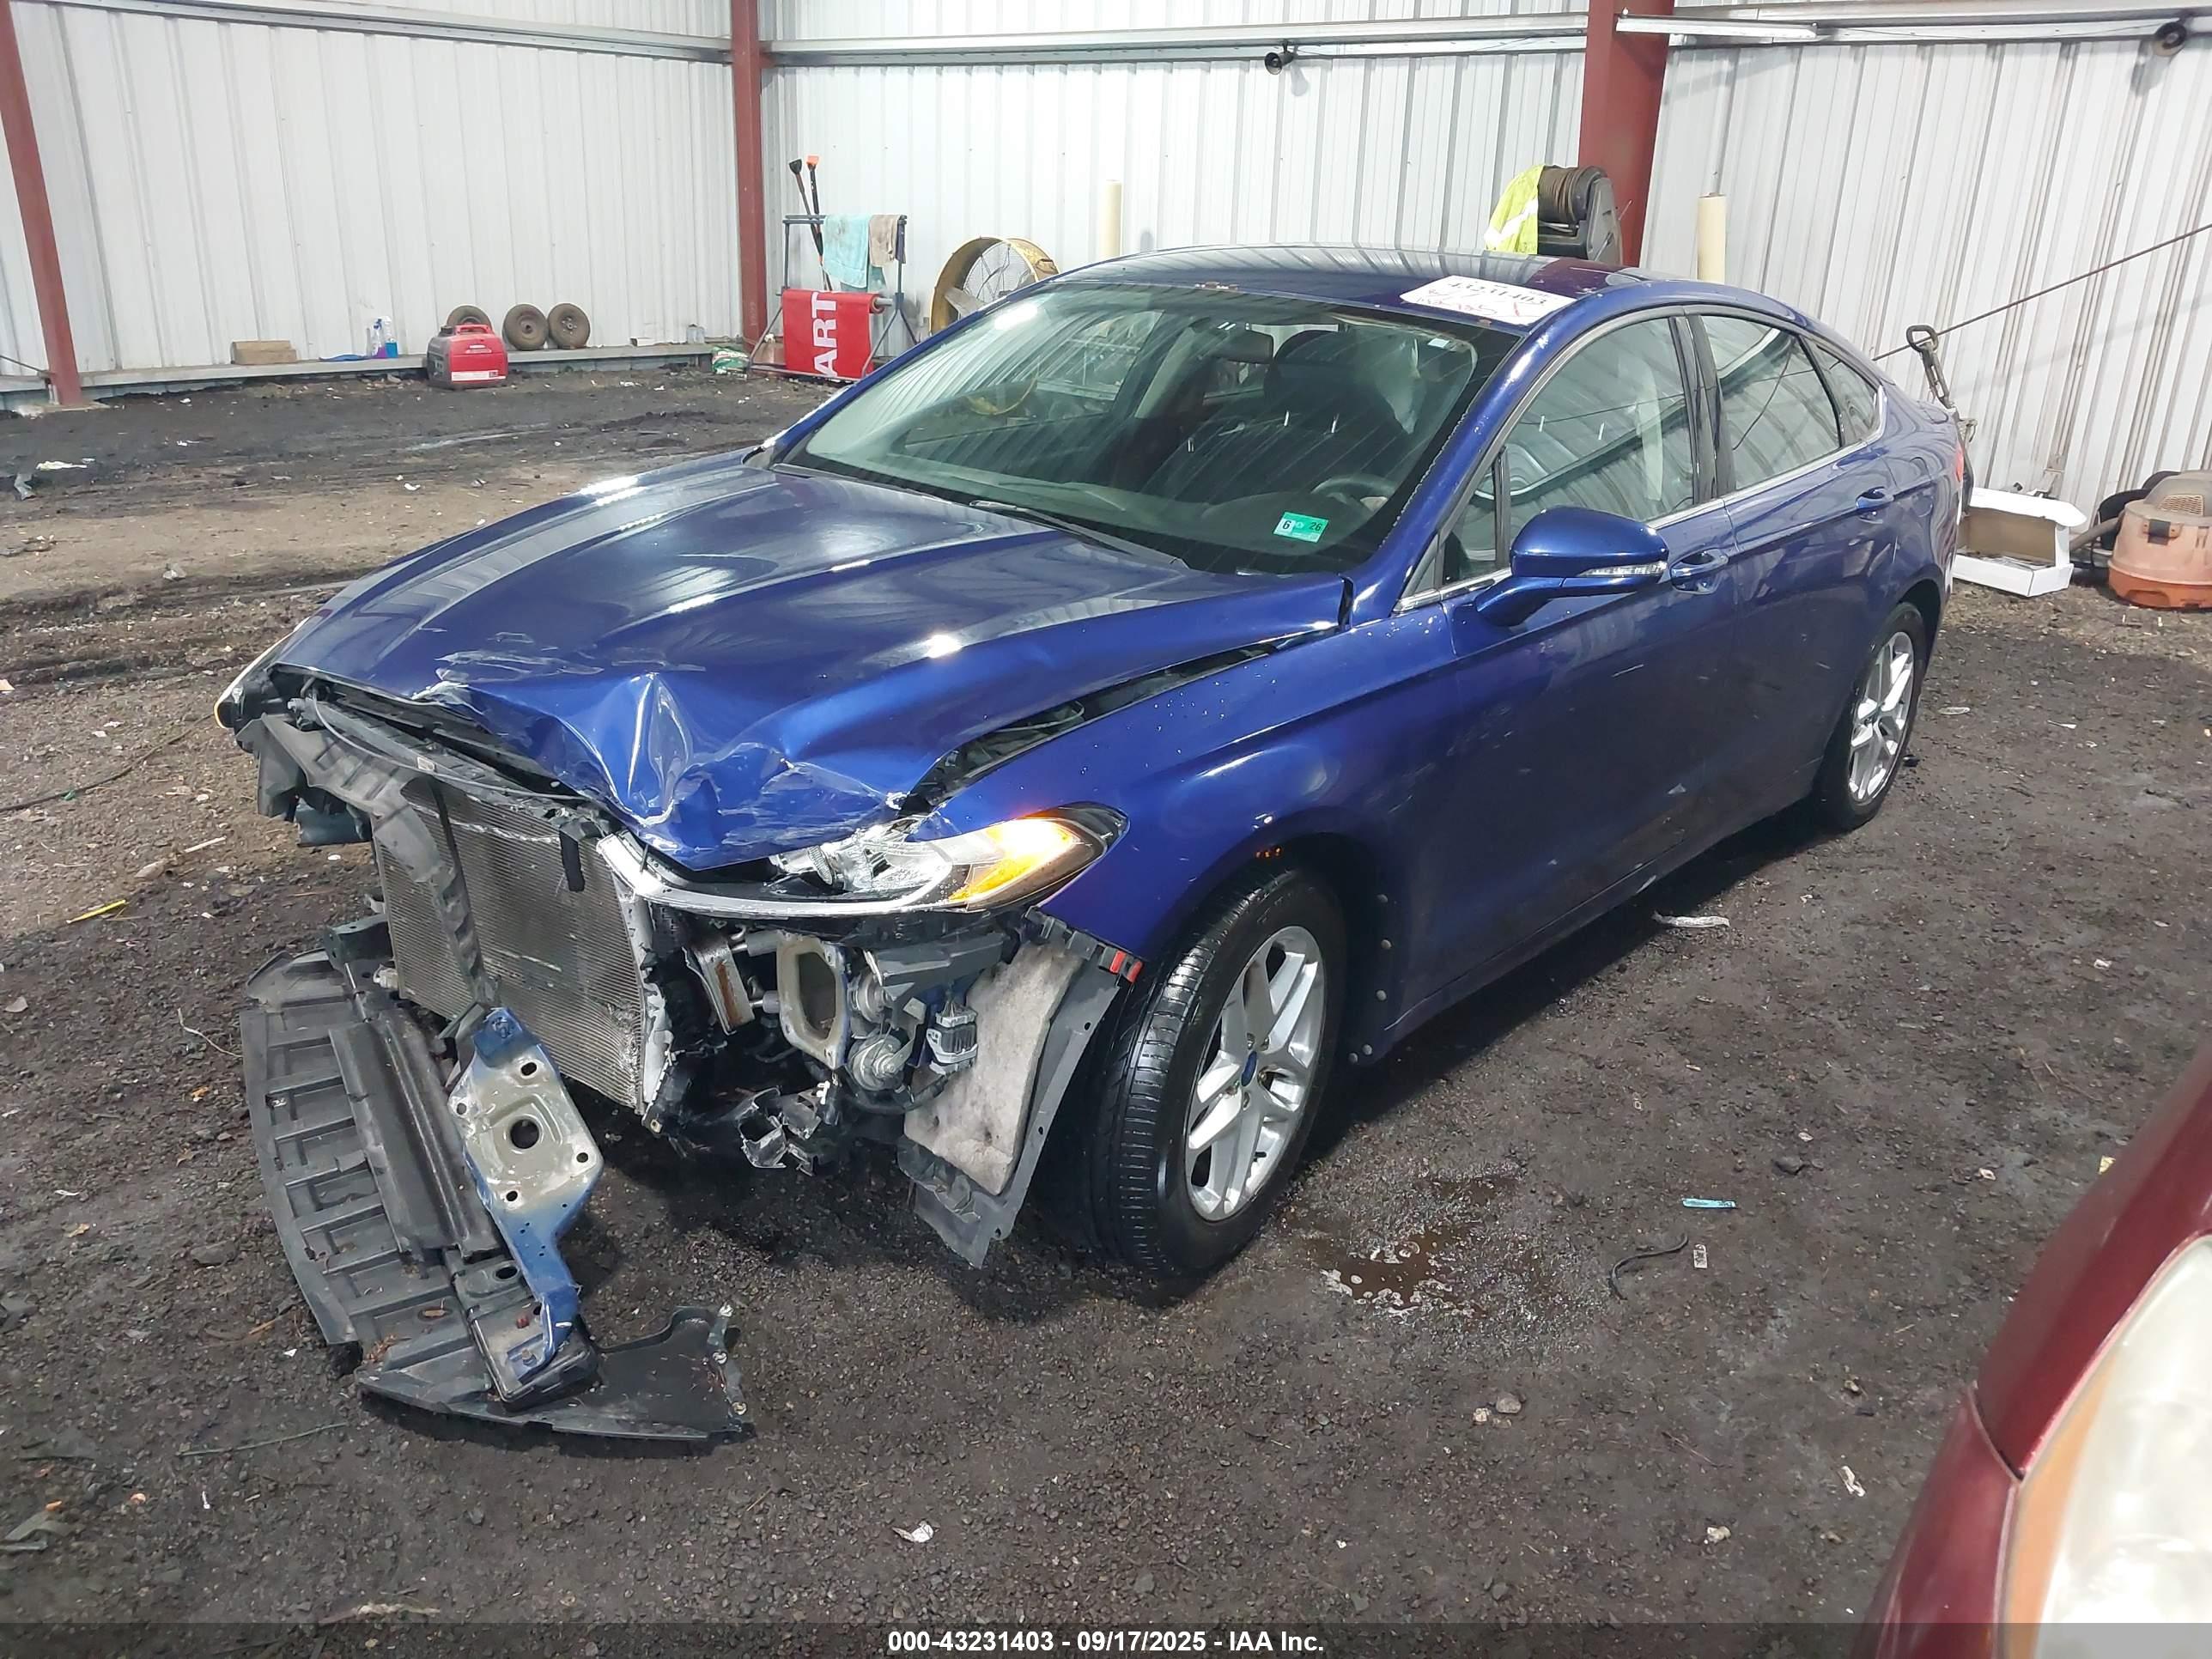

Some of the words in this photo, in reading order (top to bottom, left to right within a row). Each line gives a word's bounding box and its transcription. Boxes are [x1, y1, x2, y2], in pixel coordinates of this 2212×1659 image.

[811, 292, 839, 378] ART
[1282, 520, 1292, 530] 6
[1309, 521, 1323, 532] 26
